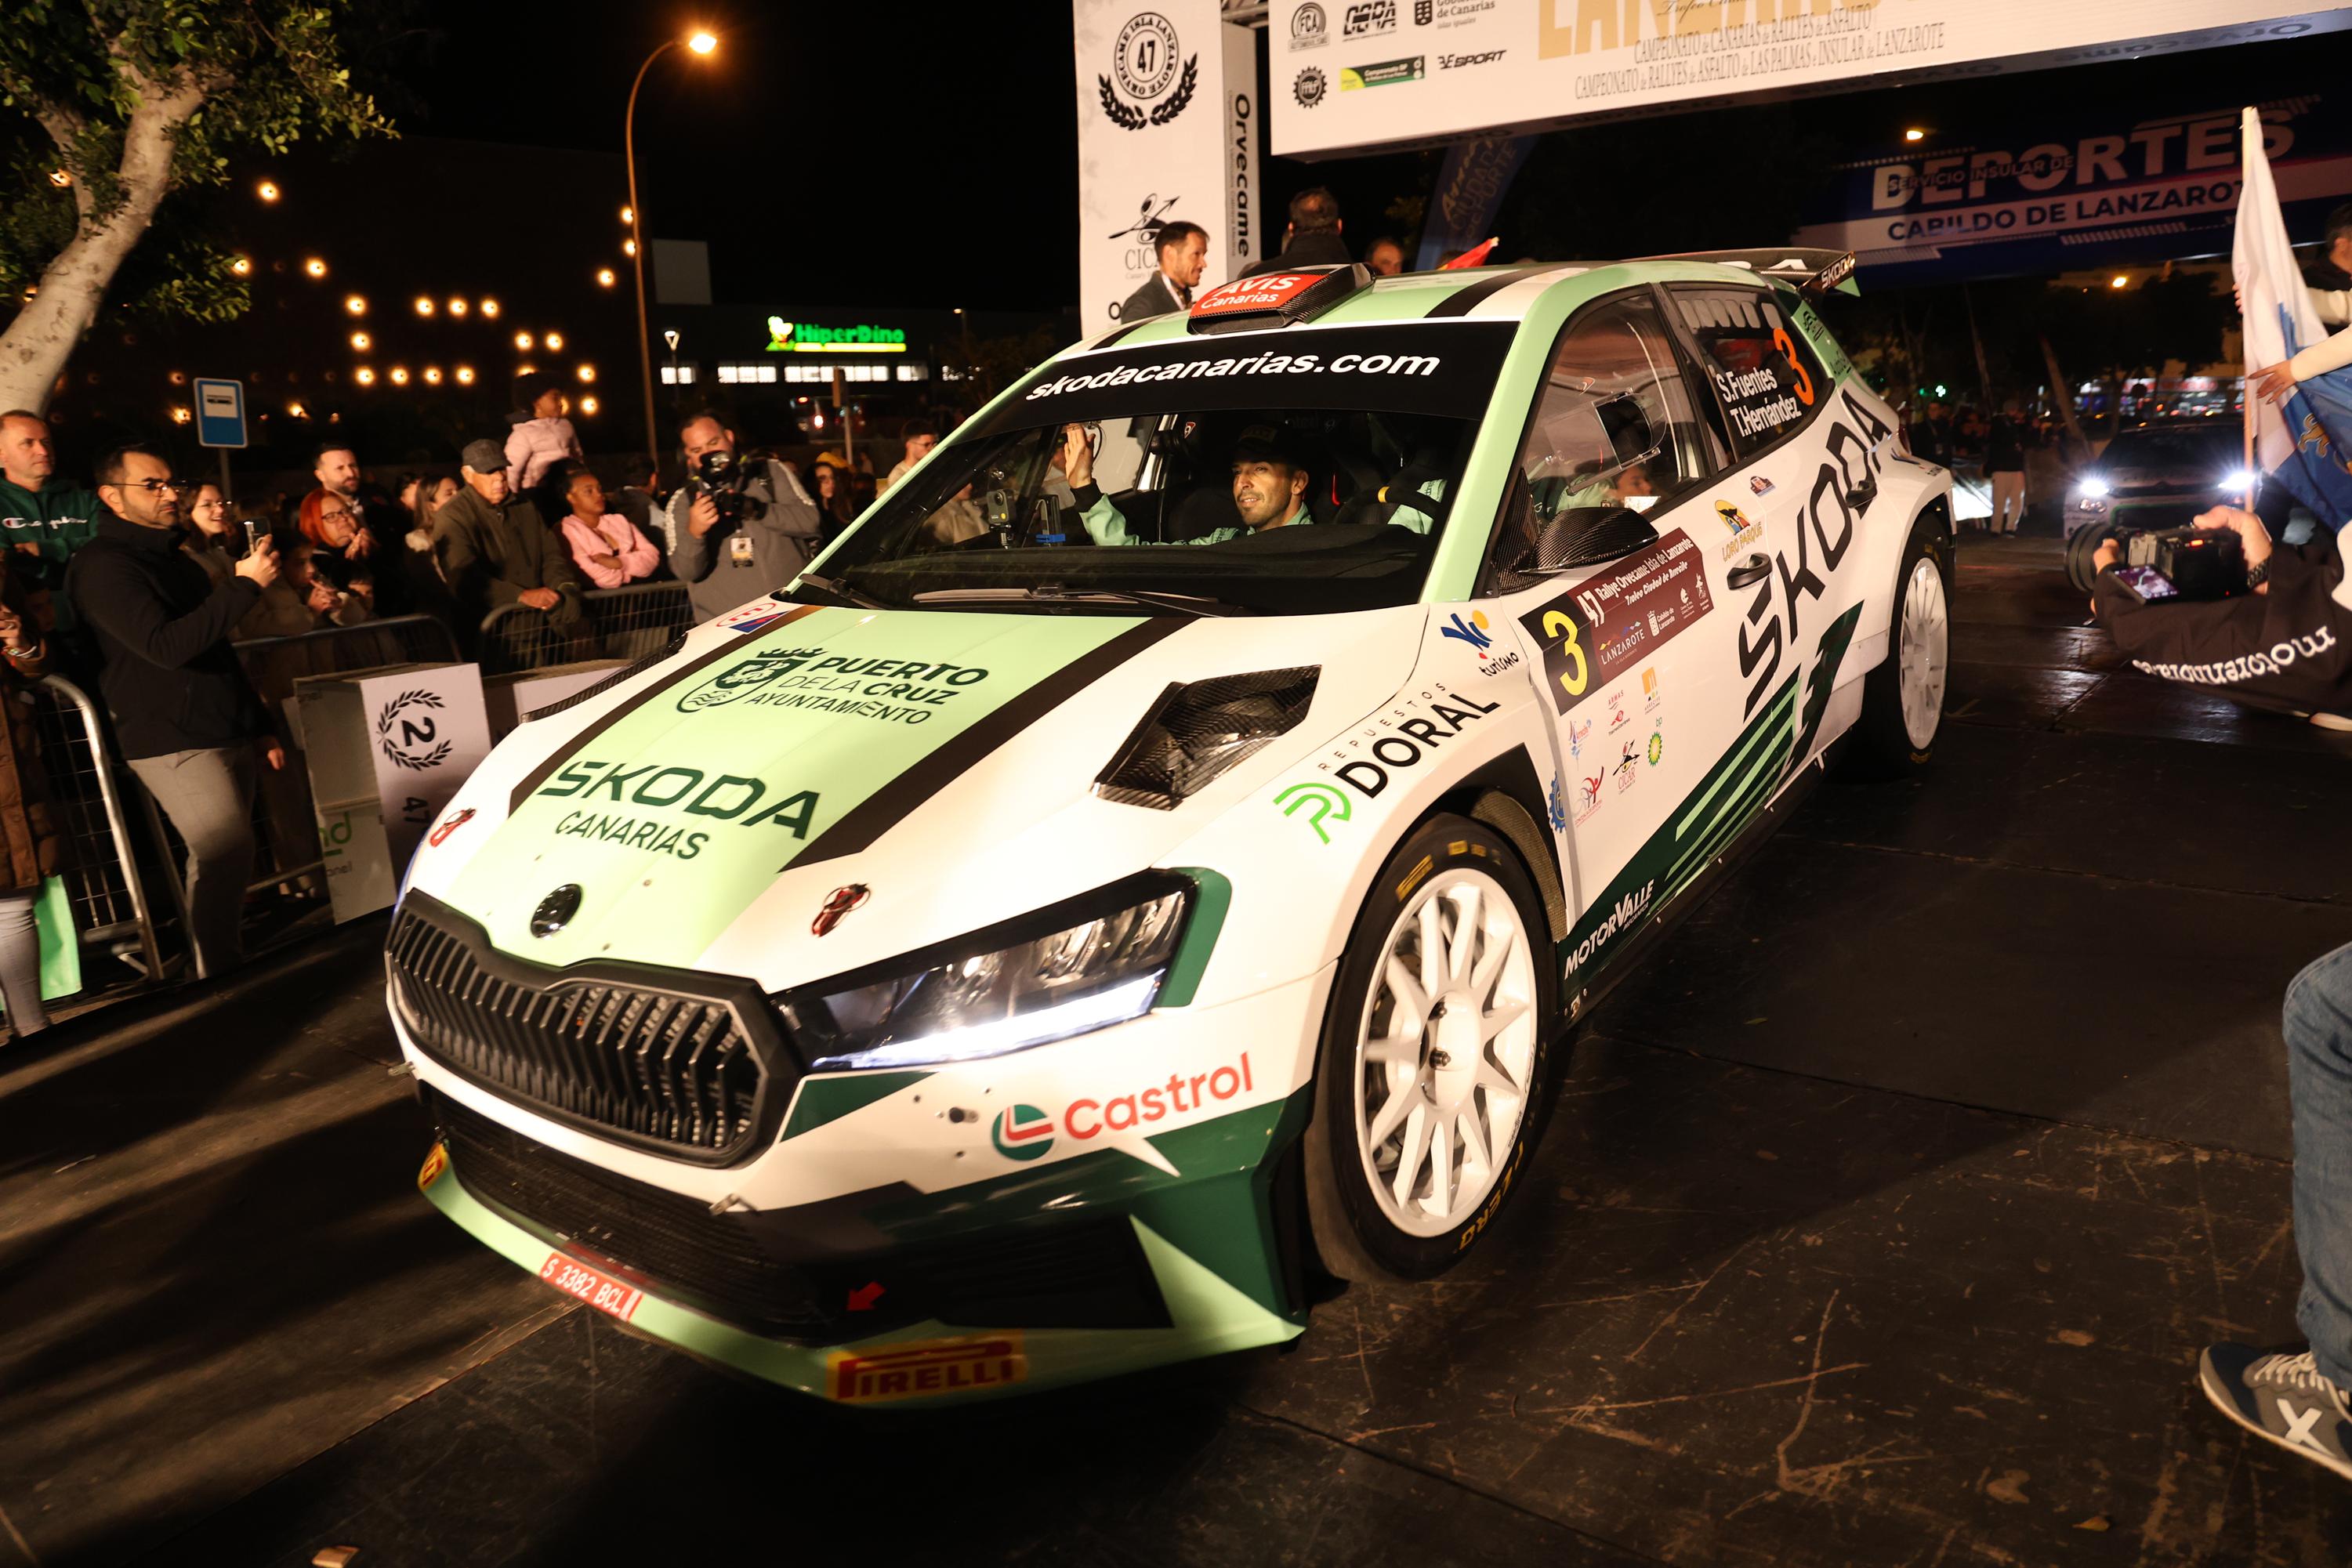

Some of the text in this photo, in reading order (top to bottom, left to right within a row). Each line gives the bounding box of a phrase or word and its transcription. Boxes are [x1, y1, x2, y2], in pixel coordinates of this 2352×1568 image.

[1129, 16, 1154, 32] ISLA
[1451, 1, 1495, 16] Canarias
[1634, 31, 1701, 63] CAMPEONATO
[1711, 21, 1763, 53] CANARIAS
[1771, 13, 1814, 42] RALLYES
[1825, 4, 1872, 36] ASFALTO
[1137, 39, 1156, 73] 47
[1575, 68, 1639, 100] CAMPEONATO
[1647, 60, 1688, 89] RALLYES
[1698, 53, 1741, 81] ASFALTO
[1750, 48, 1769, 75] LAS
[1770, 42, 1812, 73] PALMAS
[1818, 34, 1865, 66] INSULAR
[1876, 22, 1945, 56] LANZAROTE
[1235, 93, 1250, 257] Orvecame
[1872, 108, 2295, 211] DEPORTES
[1887, 156, 2075, 192] SERVICIO INSULAR DE
[1887, 179, 2243, 241] CABILDO DE LANZARO
[1125, 248, 1158, 270] CIC
[1821, 254, 1856, 289] SKODA
[1201, 291, 1279, 310] Canarias
[1212, 276, 1302, 298] AVIS
[794, 323, 905, 345] HiperDino
[1026, 352, 1440, 401] skodacanarias.com
[1716, 367, 1778, 403] S.Fuentes
[1773, 327, 1814, 405] 3
[1730, 393, 1802, 437] T.Hernández
[1722, 521, 1763, 562] LORO PARQUE
[1738, 388, 1894, 723] SKODA
[1576, 537, 1694, 628] 47 Rallye Orvecame Isla de Lanzarote
[1479, 651, 1519, 676] turismo
[1542, 610, 1589, 696] 3
[1600, 628, 1645, 665] LANZAROTE
[777, 675, 962, 705] DE LA CRUZ
[806, 656, 990, 686] PUERTO
[744, 692, 933, 725] AYUNTAMIENTO
[1317, 683, 1446, 771] REPUESTOS
[400, 716, 437, 747] 2
[1334, 693, 1502, 799] DORAL
[1618, 766, 1636, 790] CICAR
[536, 761, 821, 841] SKODA
[555, 810, 710, 860] CANARIAS
[1564, 878, 1654, 980] MOTORVALLE
[1064, 1051, 1253, 1141] Castrol
[542, 1258, 626, 1314] S 3382 BCL
[836, 1340, 1013, 1400] PIRELLI
